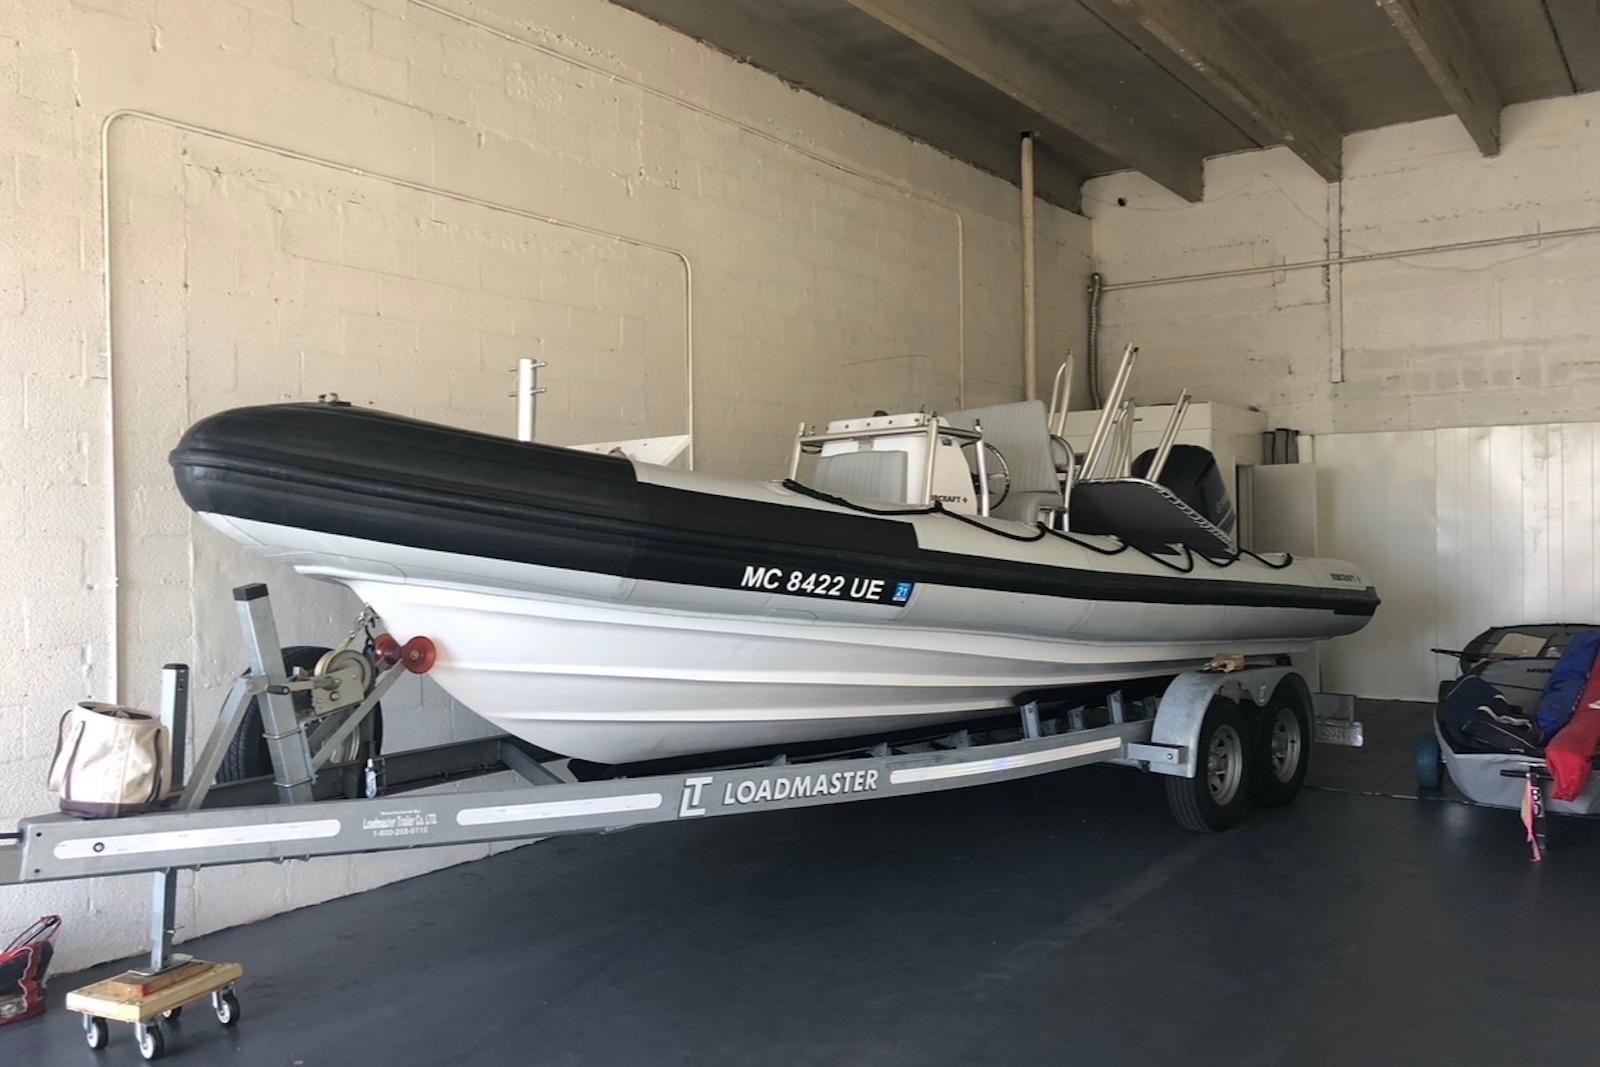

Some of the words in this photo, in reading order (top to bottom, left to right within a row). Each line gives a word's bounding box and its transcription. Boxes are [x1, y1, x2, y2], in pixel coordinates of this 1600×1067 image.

[741, 566, 782, 589] MC
[786, 571, 845, 596] 8422
[850, 578, 885, 600] UE
[722, 769, 878, 806] LOADMASTER
